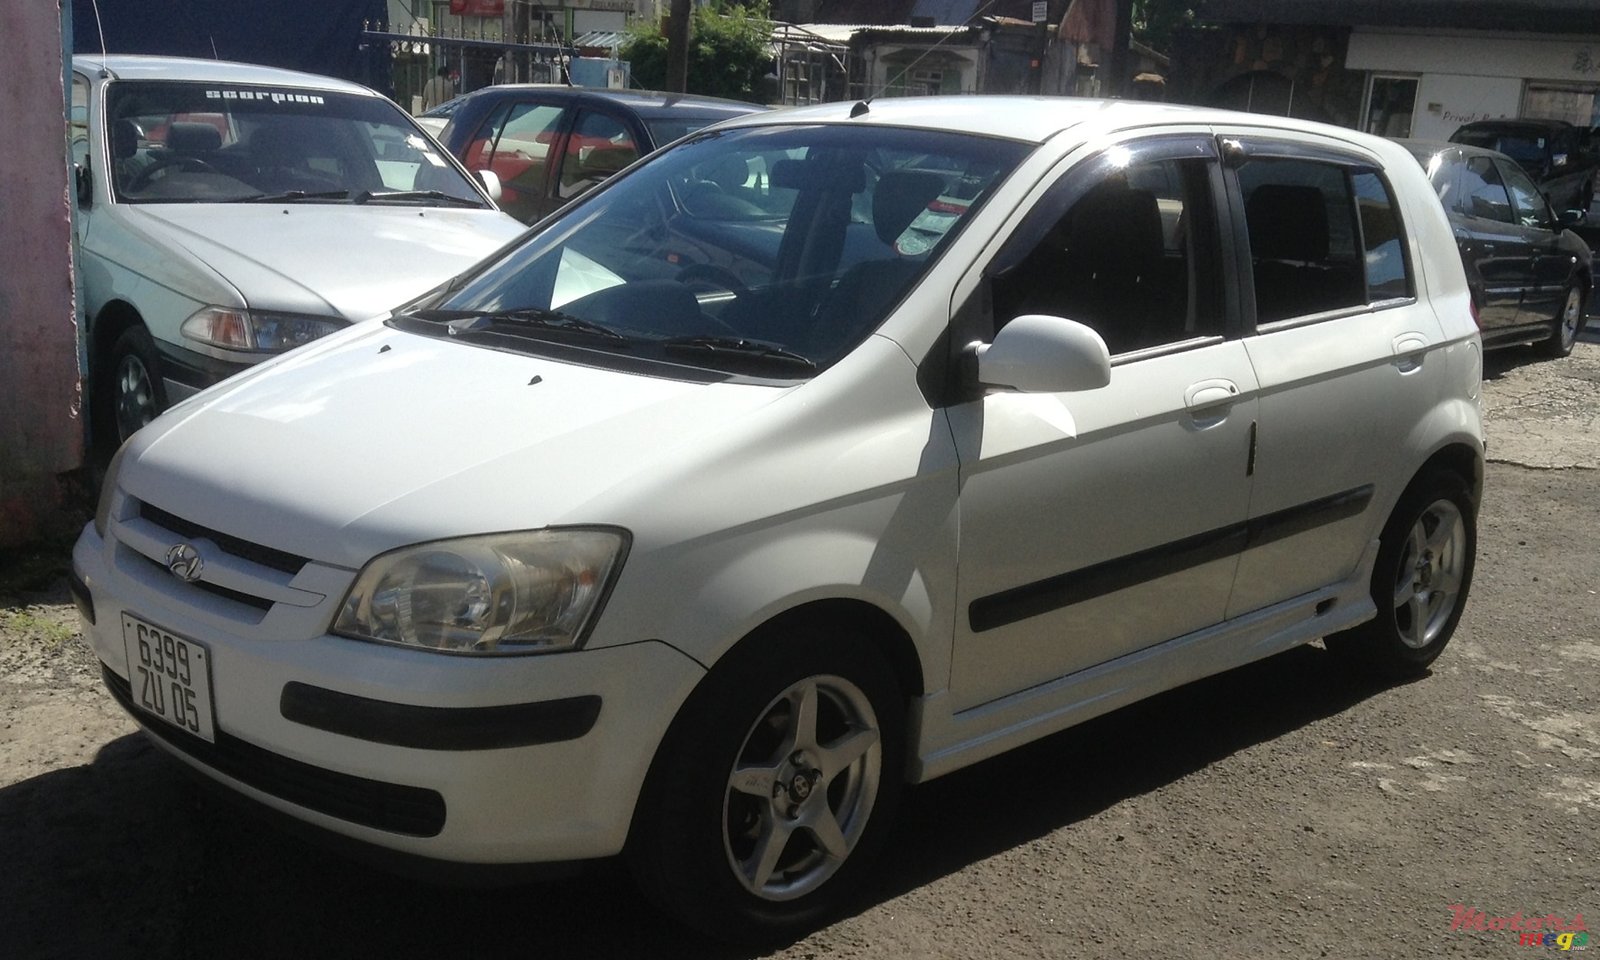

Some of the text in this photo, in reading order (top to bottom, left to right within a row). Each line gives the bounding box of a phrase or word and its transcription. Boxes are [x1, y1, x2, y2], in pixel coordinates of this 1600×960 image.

[137, 624, 191, 687] 6399
[138, 665, 199, 733] ZU 05
